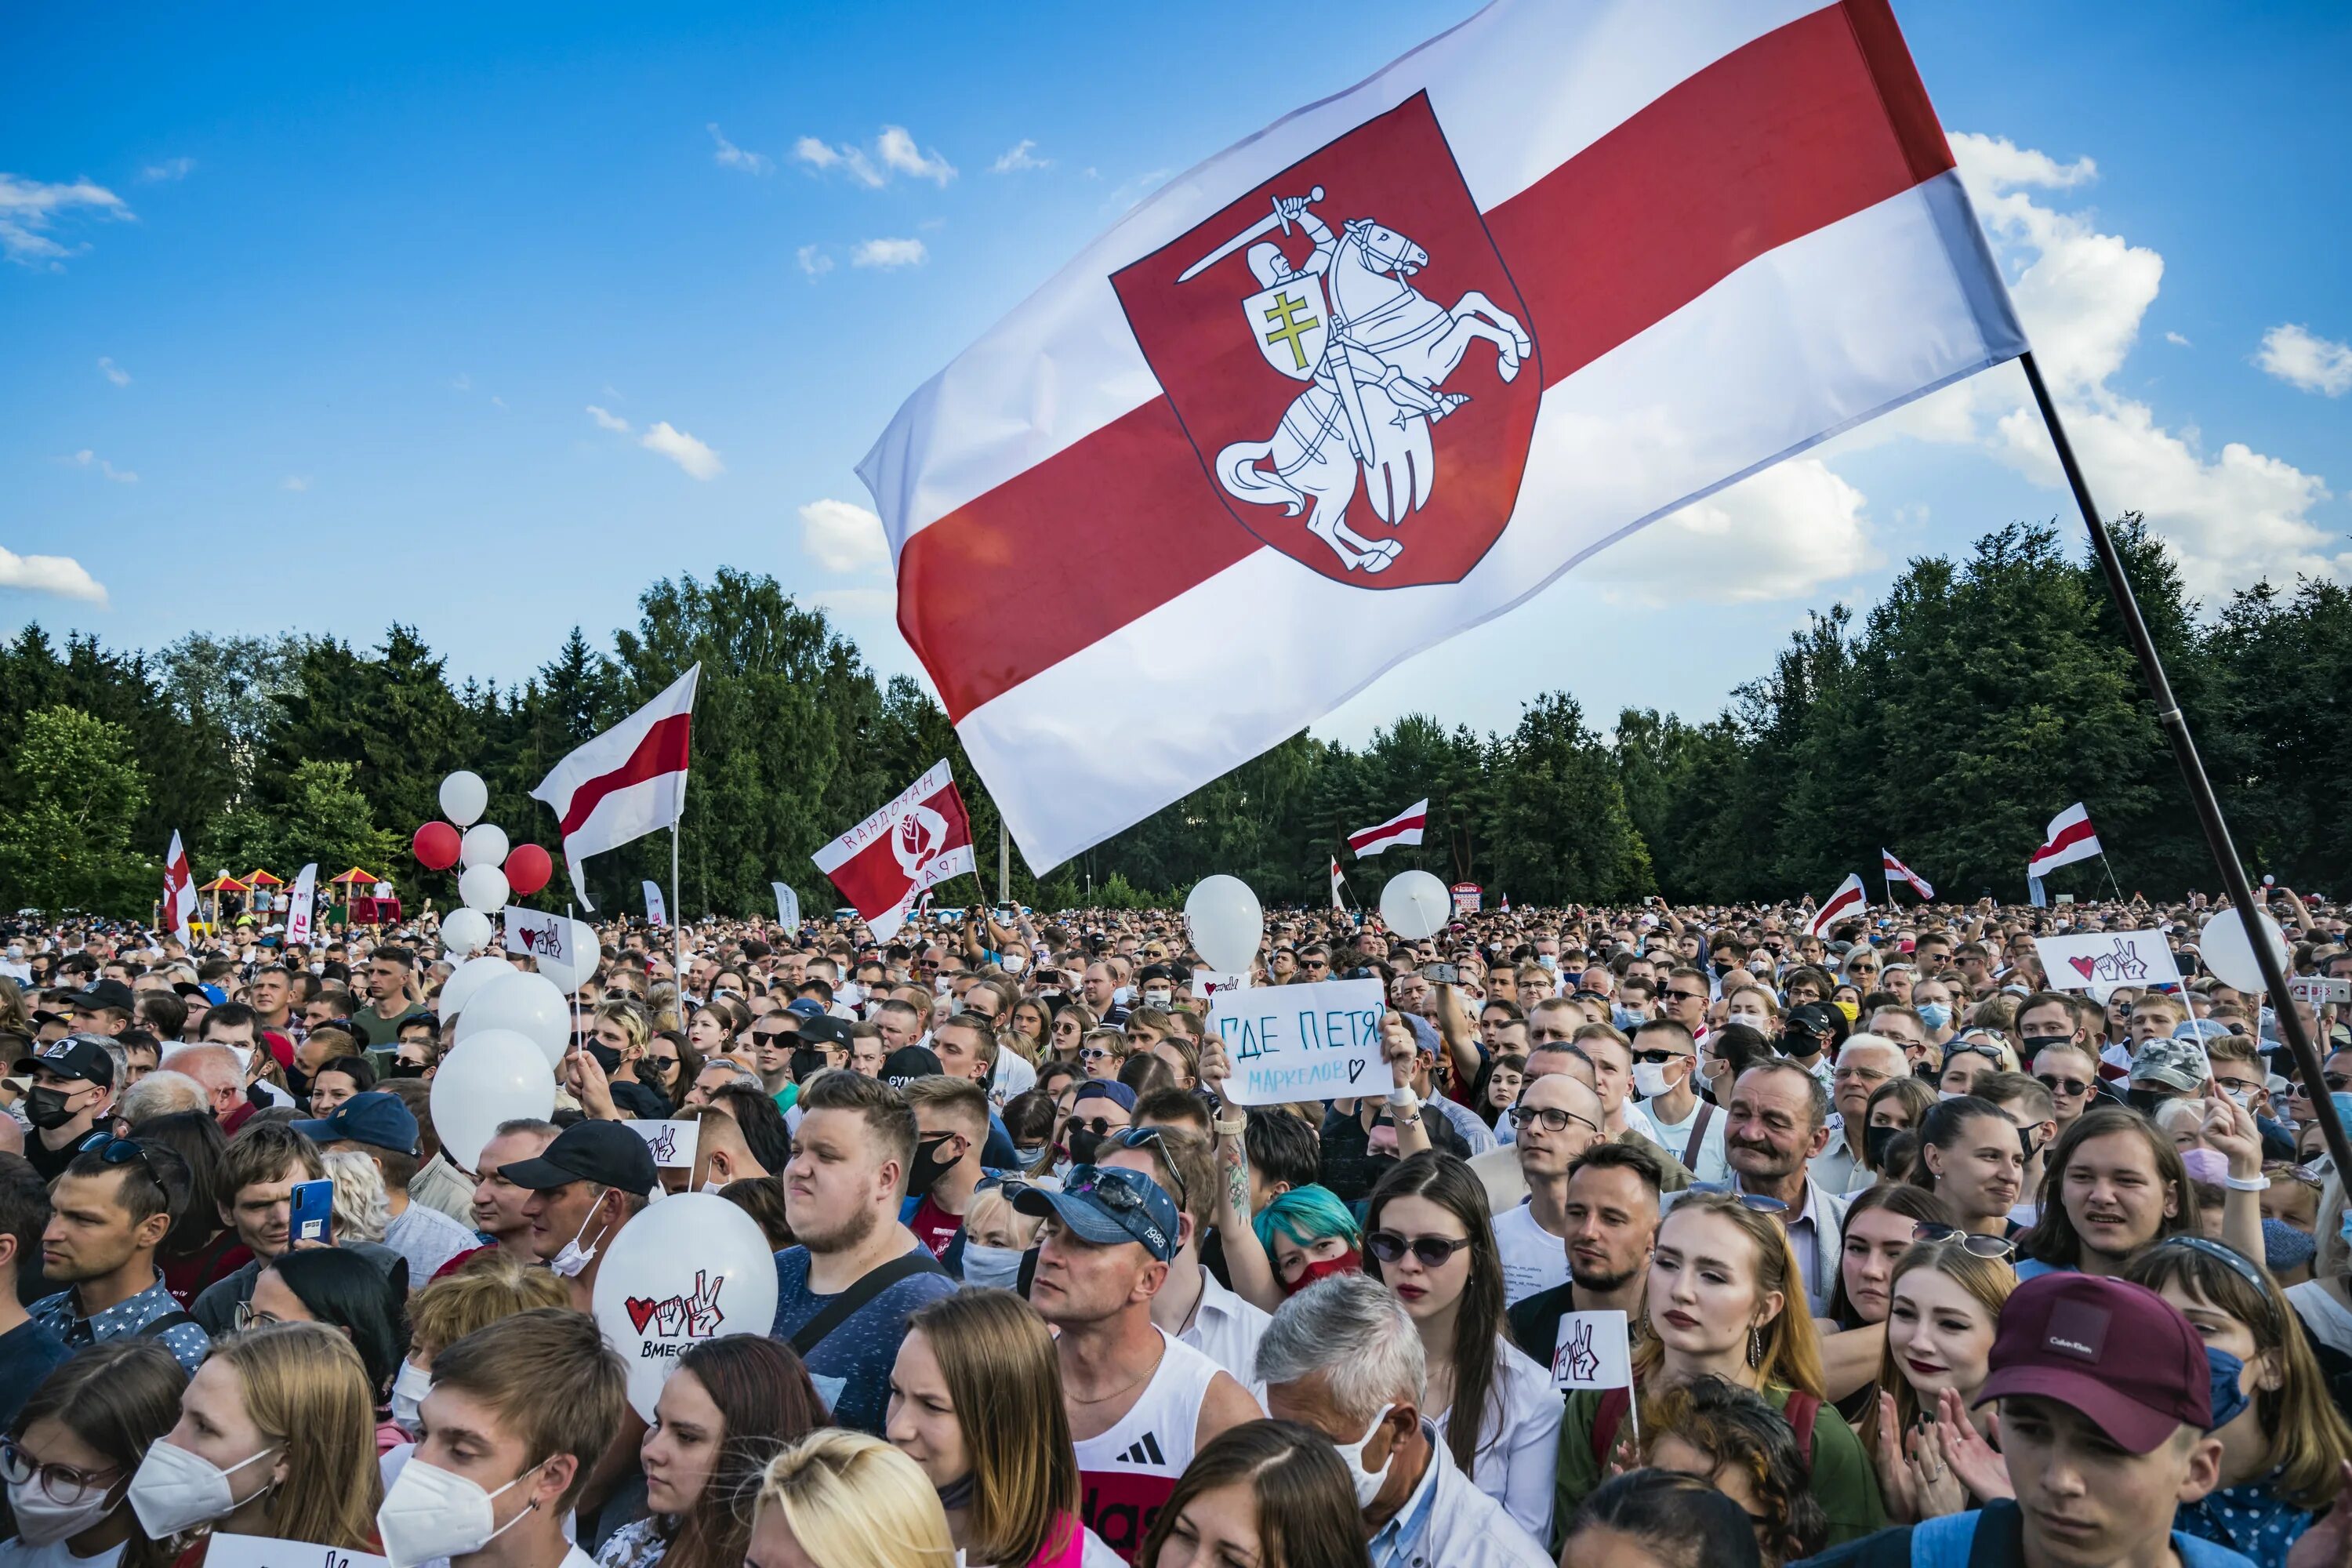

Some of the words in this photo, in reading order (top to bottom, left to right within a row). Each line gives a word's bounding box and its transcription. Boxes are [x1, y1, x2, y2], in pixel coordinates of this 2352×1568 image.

[1220, 1016, 1280, 1064] ГДЕ
[889, 1076, 915, 1087] GYM
[1248, 1060, 1347, 1094] МАРКЕЛОВ
[1145, 1226, 1166, 1248] 1985
[2049, 1337, 2074, 1348] Calvin
